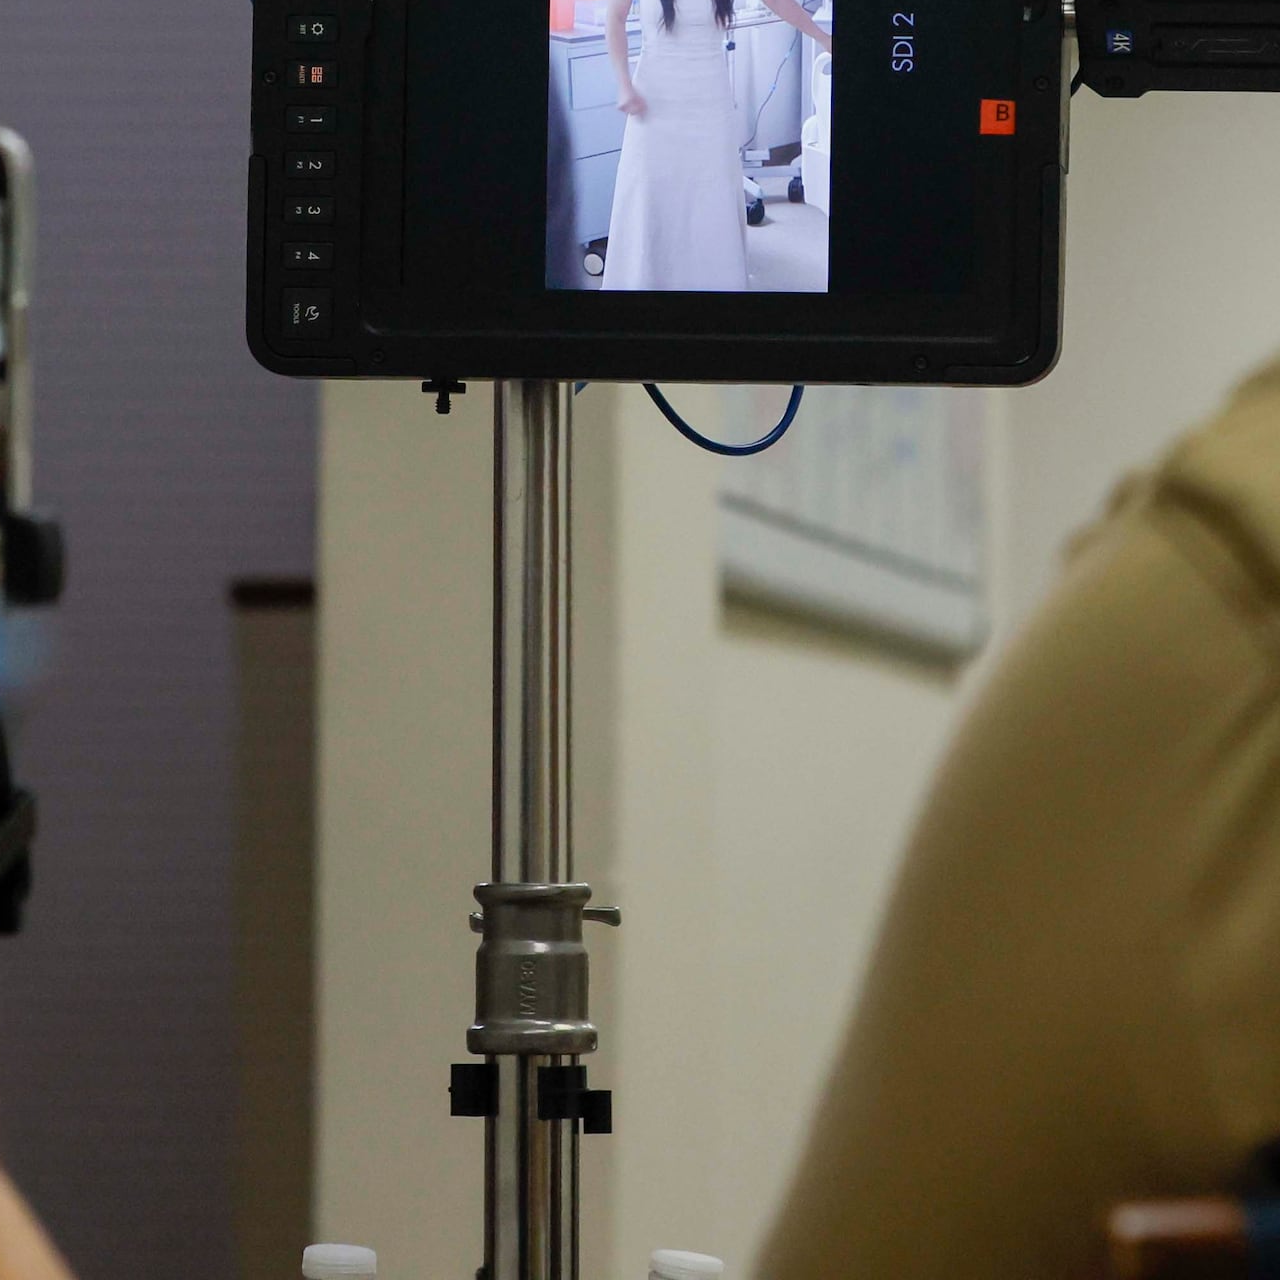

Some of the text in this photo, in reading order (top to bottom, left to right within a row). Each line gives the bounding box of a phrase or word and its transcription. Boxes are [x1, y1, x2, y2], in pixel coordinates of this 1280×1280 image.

[891, 12, 914, 73] SDI 2
[1112, 32, 1131, 53] 4K
[298, 64, 306, 84] MULTI
[996, 103, 1009, 122] B
[308, 160, 322, 170] 2
[307, 205, 321, 215] 3
[307, 250, 320, 261] 4
[292, 302, 301, 325] TOOLS
